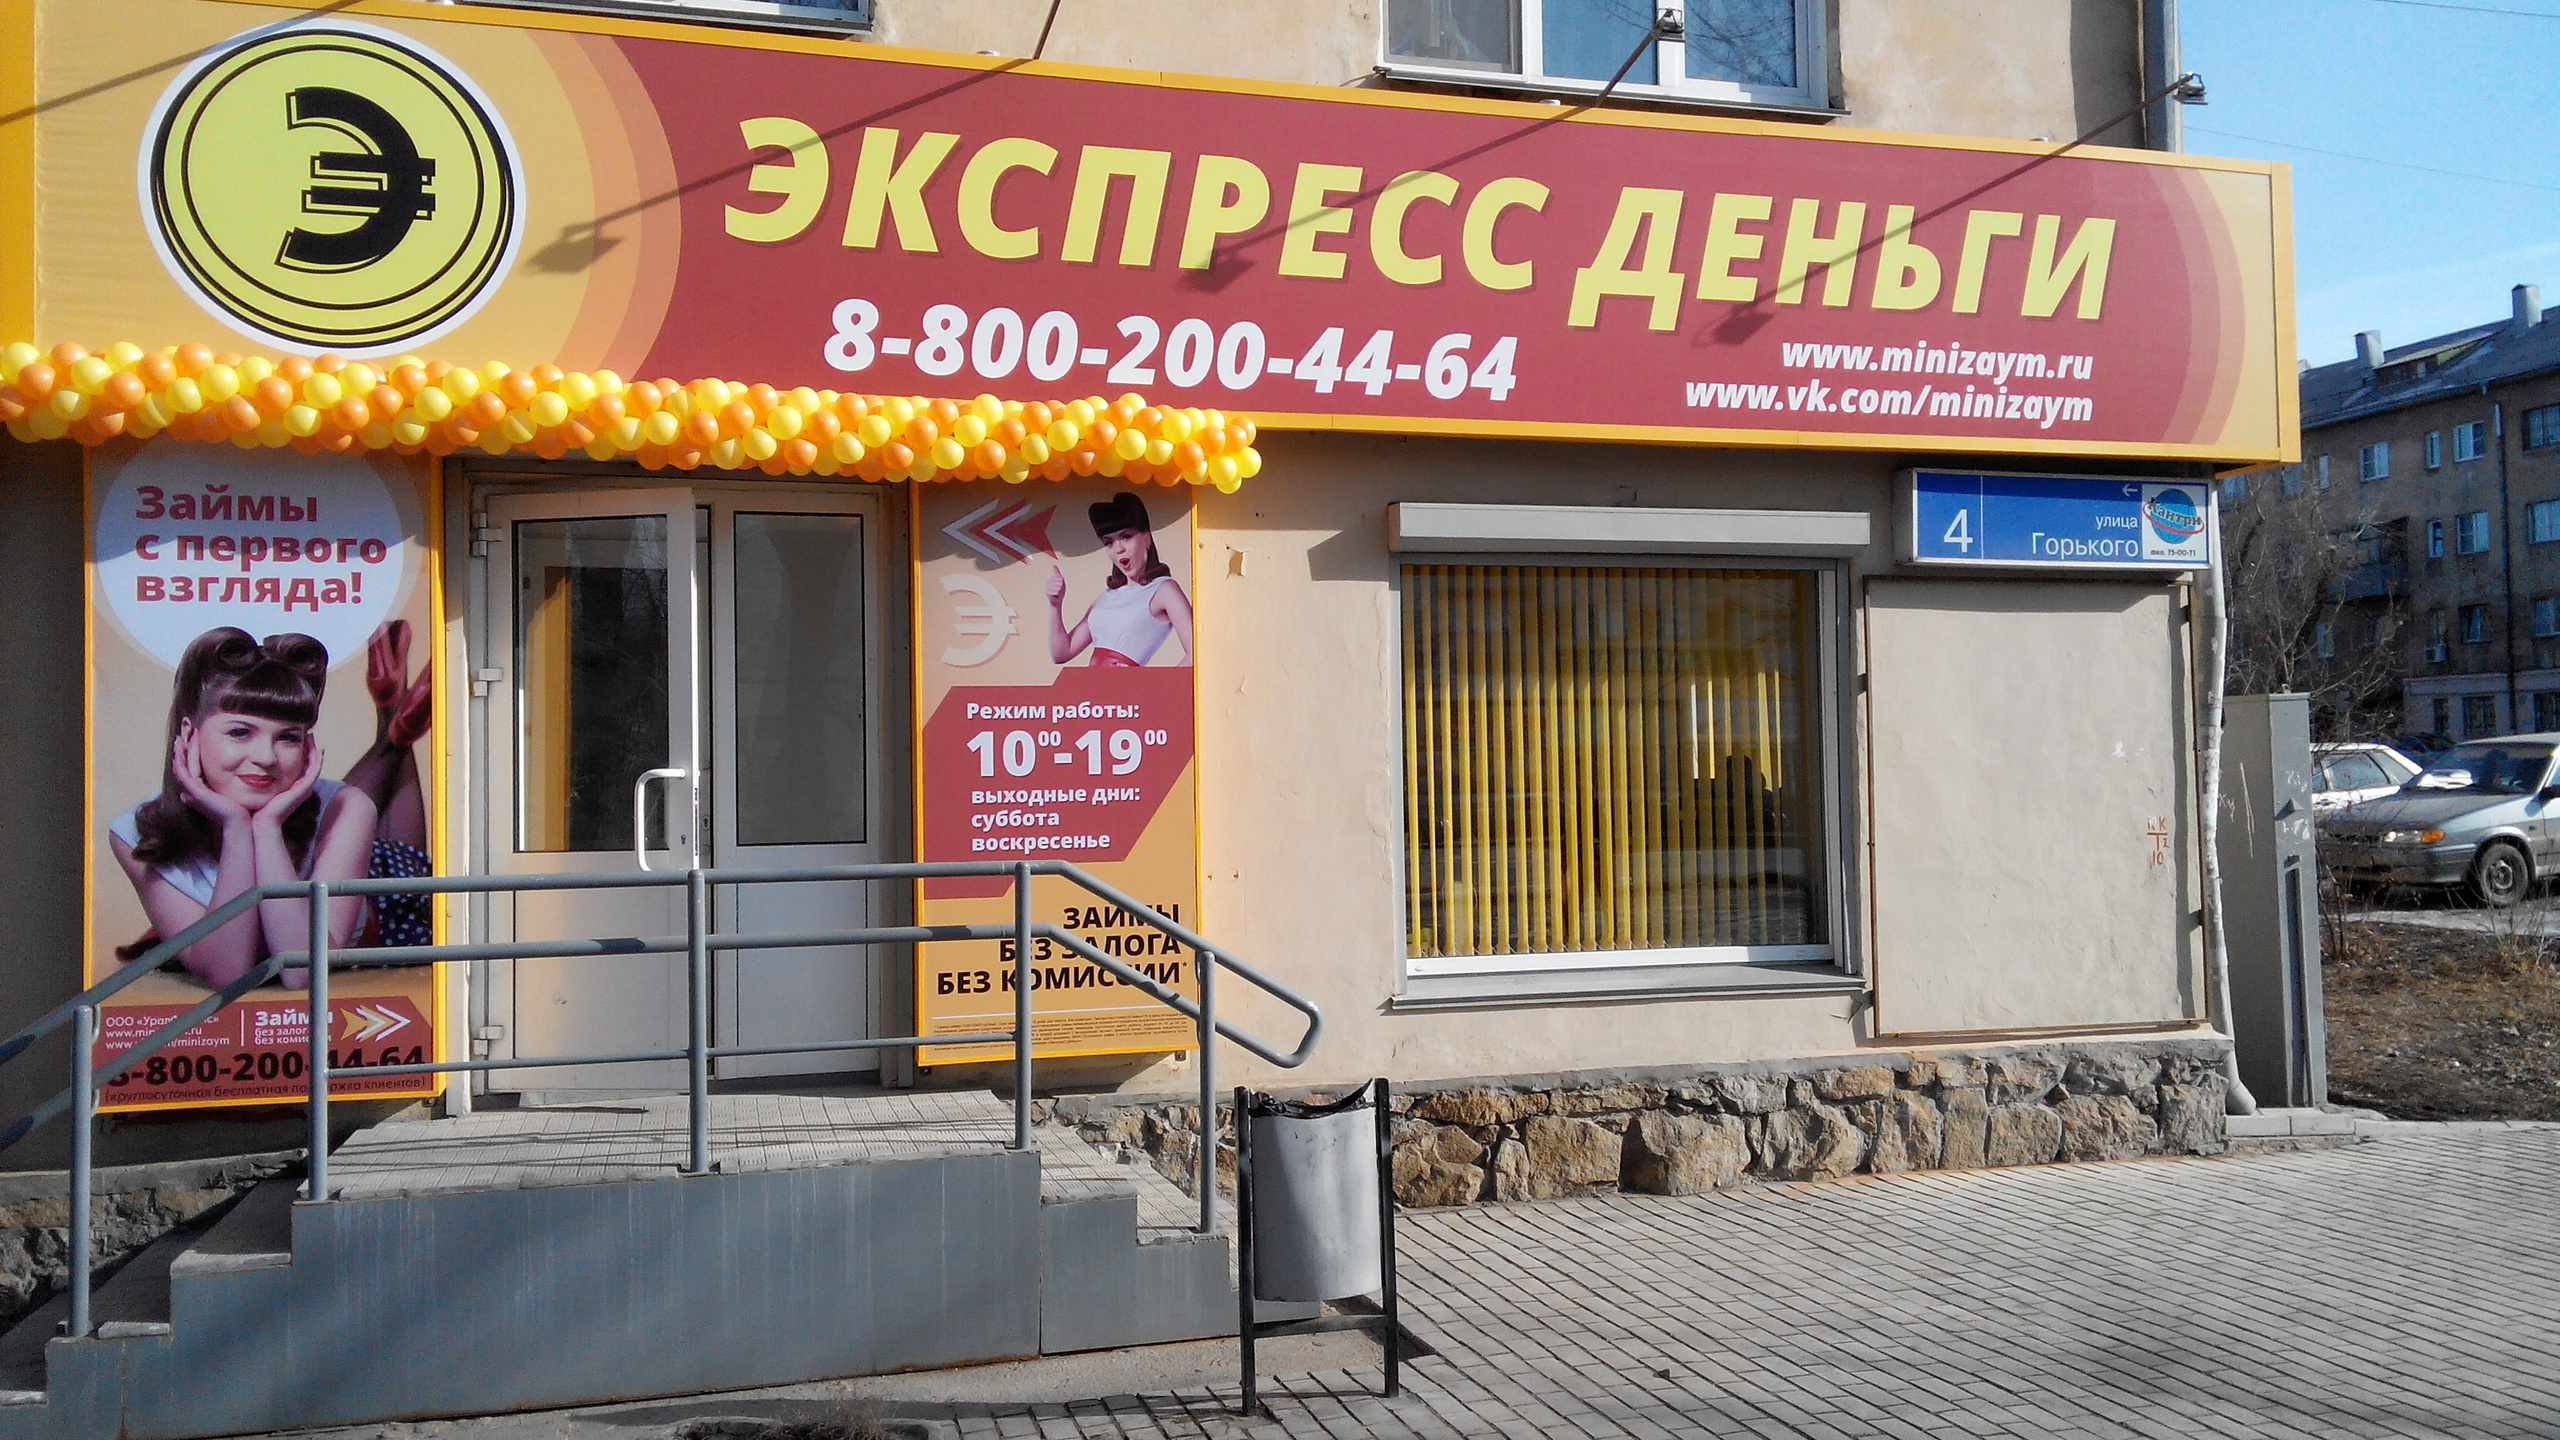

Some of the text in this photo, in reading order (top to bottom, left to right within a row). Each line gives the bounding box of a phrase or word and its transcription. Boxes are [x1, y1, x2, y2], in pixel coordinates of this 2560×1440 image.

[725, 116, 2117, 331] ЭКСПРЕСС ДЕНЬГИ
[824, 298, 1519, 401] 8-800-200-44-64
[1781, 340, 2095, 384] www.minizaym.ru
[1685, 381, 2095, 428] www.vk.com/minizaym
[135, 484, 319, 523] Займы
[1943, 508, 1974, 554] 4
[2095, 514, 2138, 530] улица
[135, 534, 388, 572] с первого
[2031, 532, 2139, 560] Горького
[136, 571, 363, 612] взгляда!
[967, 701, 1140, 723] Режим работы:
[971, 786, 1141, 807] выходные дни:
[971, 809, 1060, 832] суббота
[971, 833, 1111, 855] воскресенье
[1000, 938, 1052, 962] БЗ
[937, 970, 992, 995] БЕЗ
[105, 1016, 135, 1028] ООО
[255, 1027, 309, 1037] без залог
[254, 1036, 274, 1045] без
